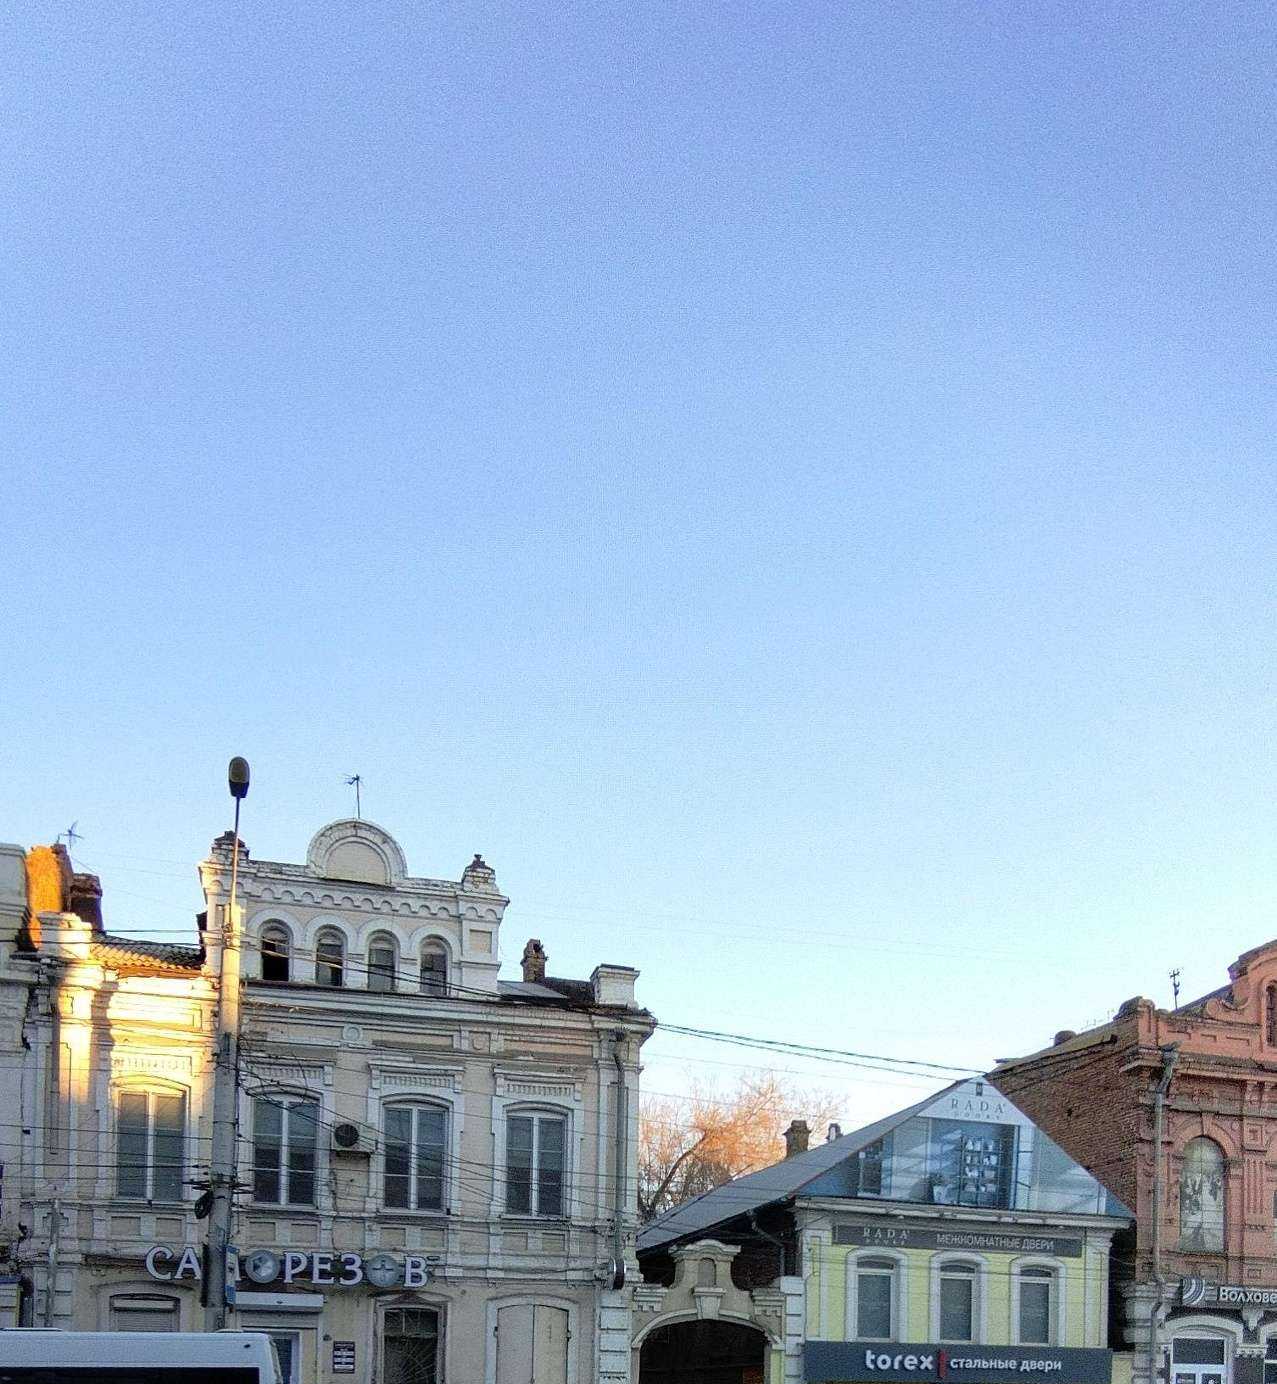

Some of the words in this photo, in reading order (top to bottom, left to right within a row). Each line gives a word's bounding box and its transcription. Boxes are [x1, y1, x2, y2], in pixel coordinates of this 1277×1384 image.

[1022, 1239, 1054, 1251] ДВЕРИ
[865, 1350, 933, 1370] torex
[950, 1357, 1017, 1370] стальные
[1019, 1360, 1062, 1374] двери
